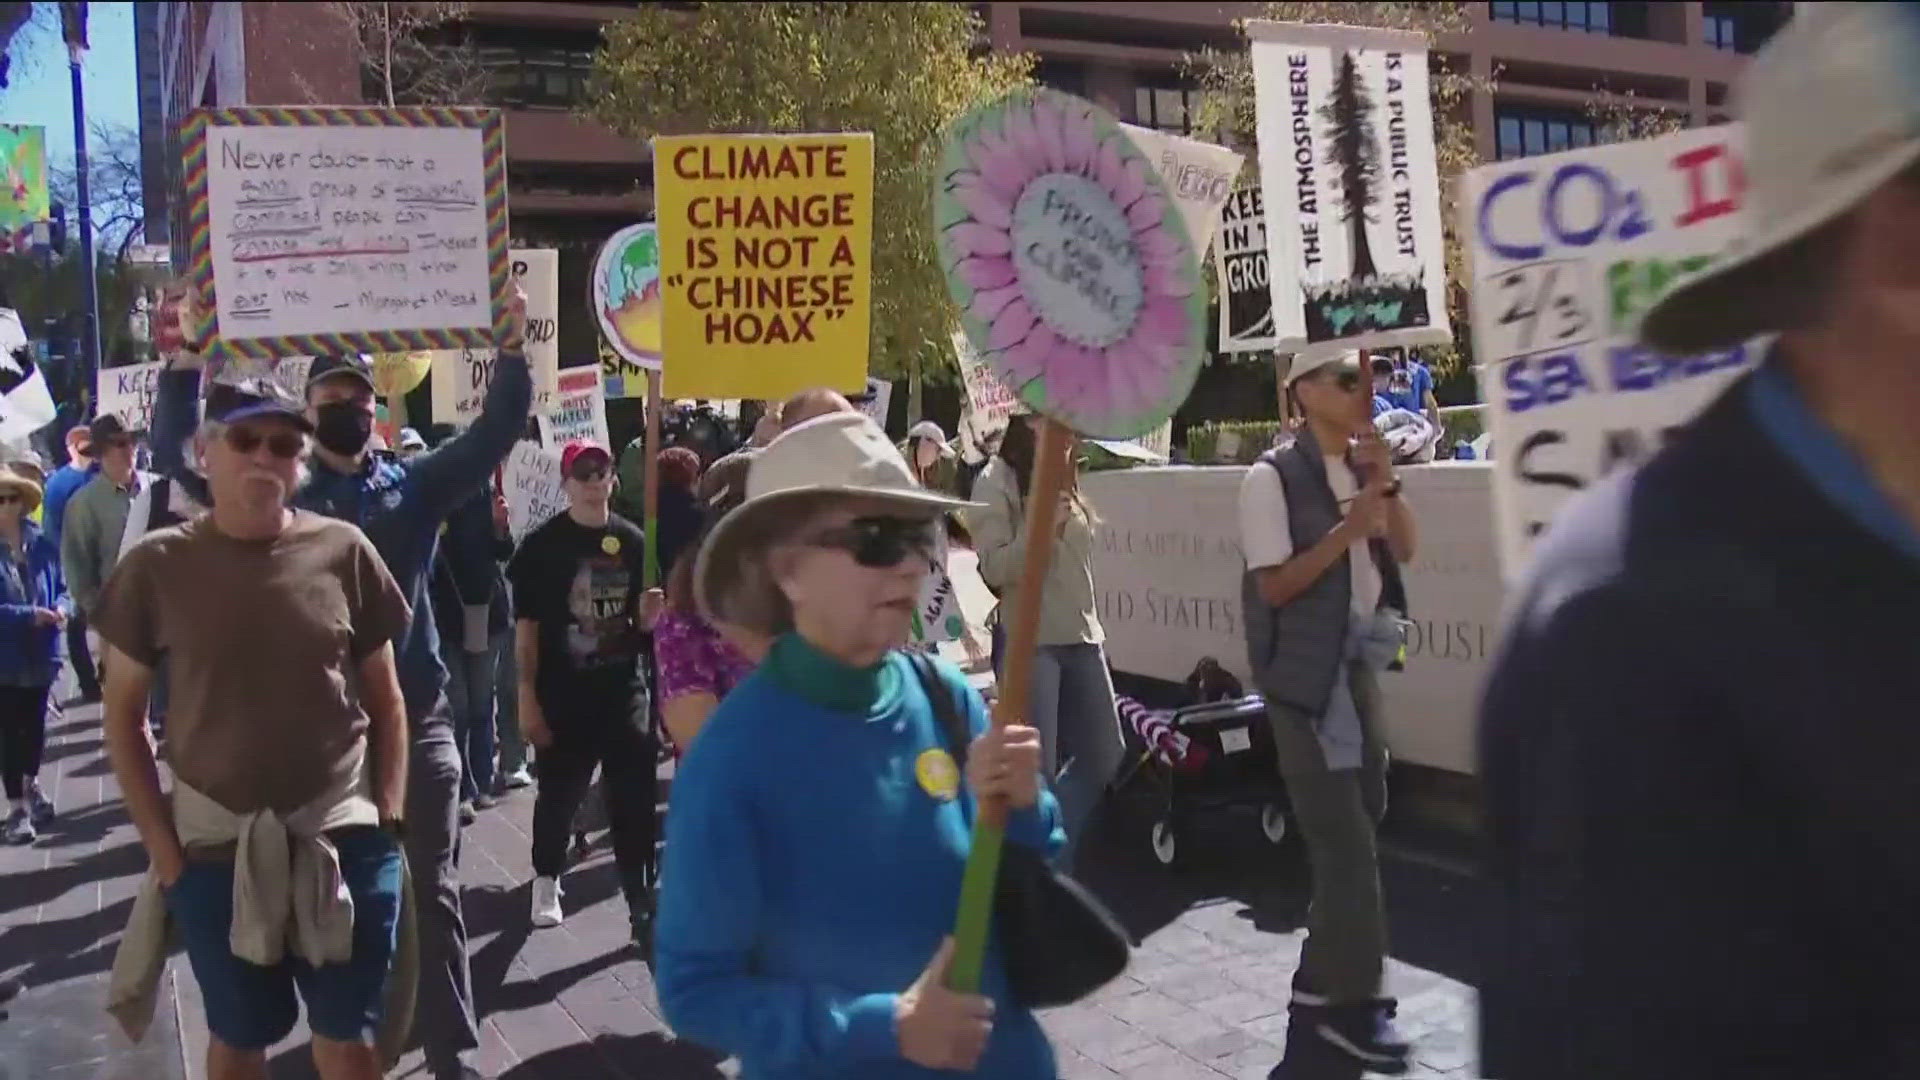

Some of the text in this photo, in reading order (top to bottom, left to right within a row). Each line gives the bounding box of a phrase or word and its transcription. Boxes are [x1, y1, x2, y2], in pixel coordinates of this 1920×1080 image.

[222, 138, 302, 170] Never
[673, 145, 848, 181] CLIMATE
[1287, 53, 1322, 269] THE ATMOSPHERE
[1385, 52, 1417, 258] IS A PUBLIC TRUST
[687, 193, 855, 229] CHANGE
[1222, 187, 1264, 223] KEE
[686, 234, 855, 269] IS NOT A
[1224, 224, 1248, 250] IN
[1227, 256, 1269, 293] GRO
